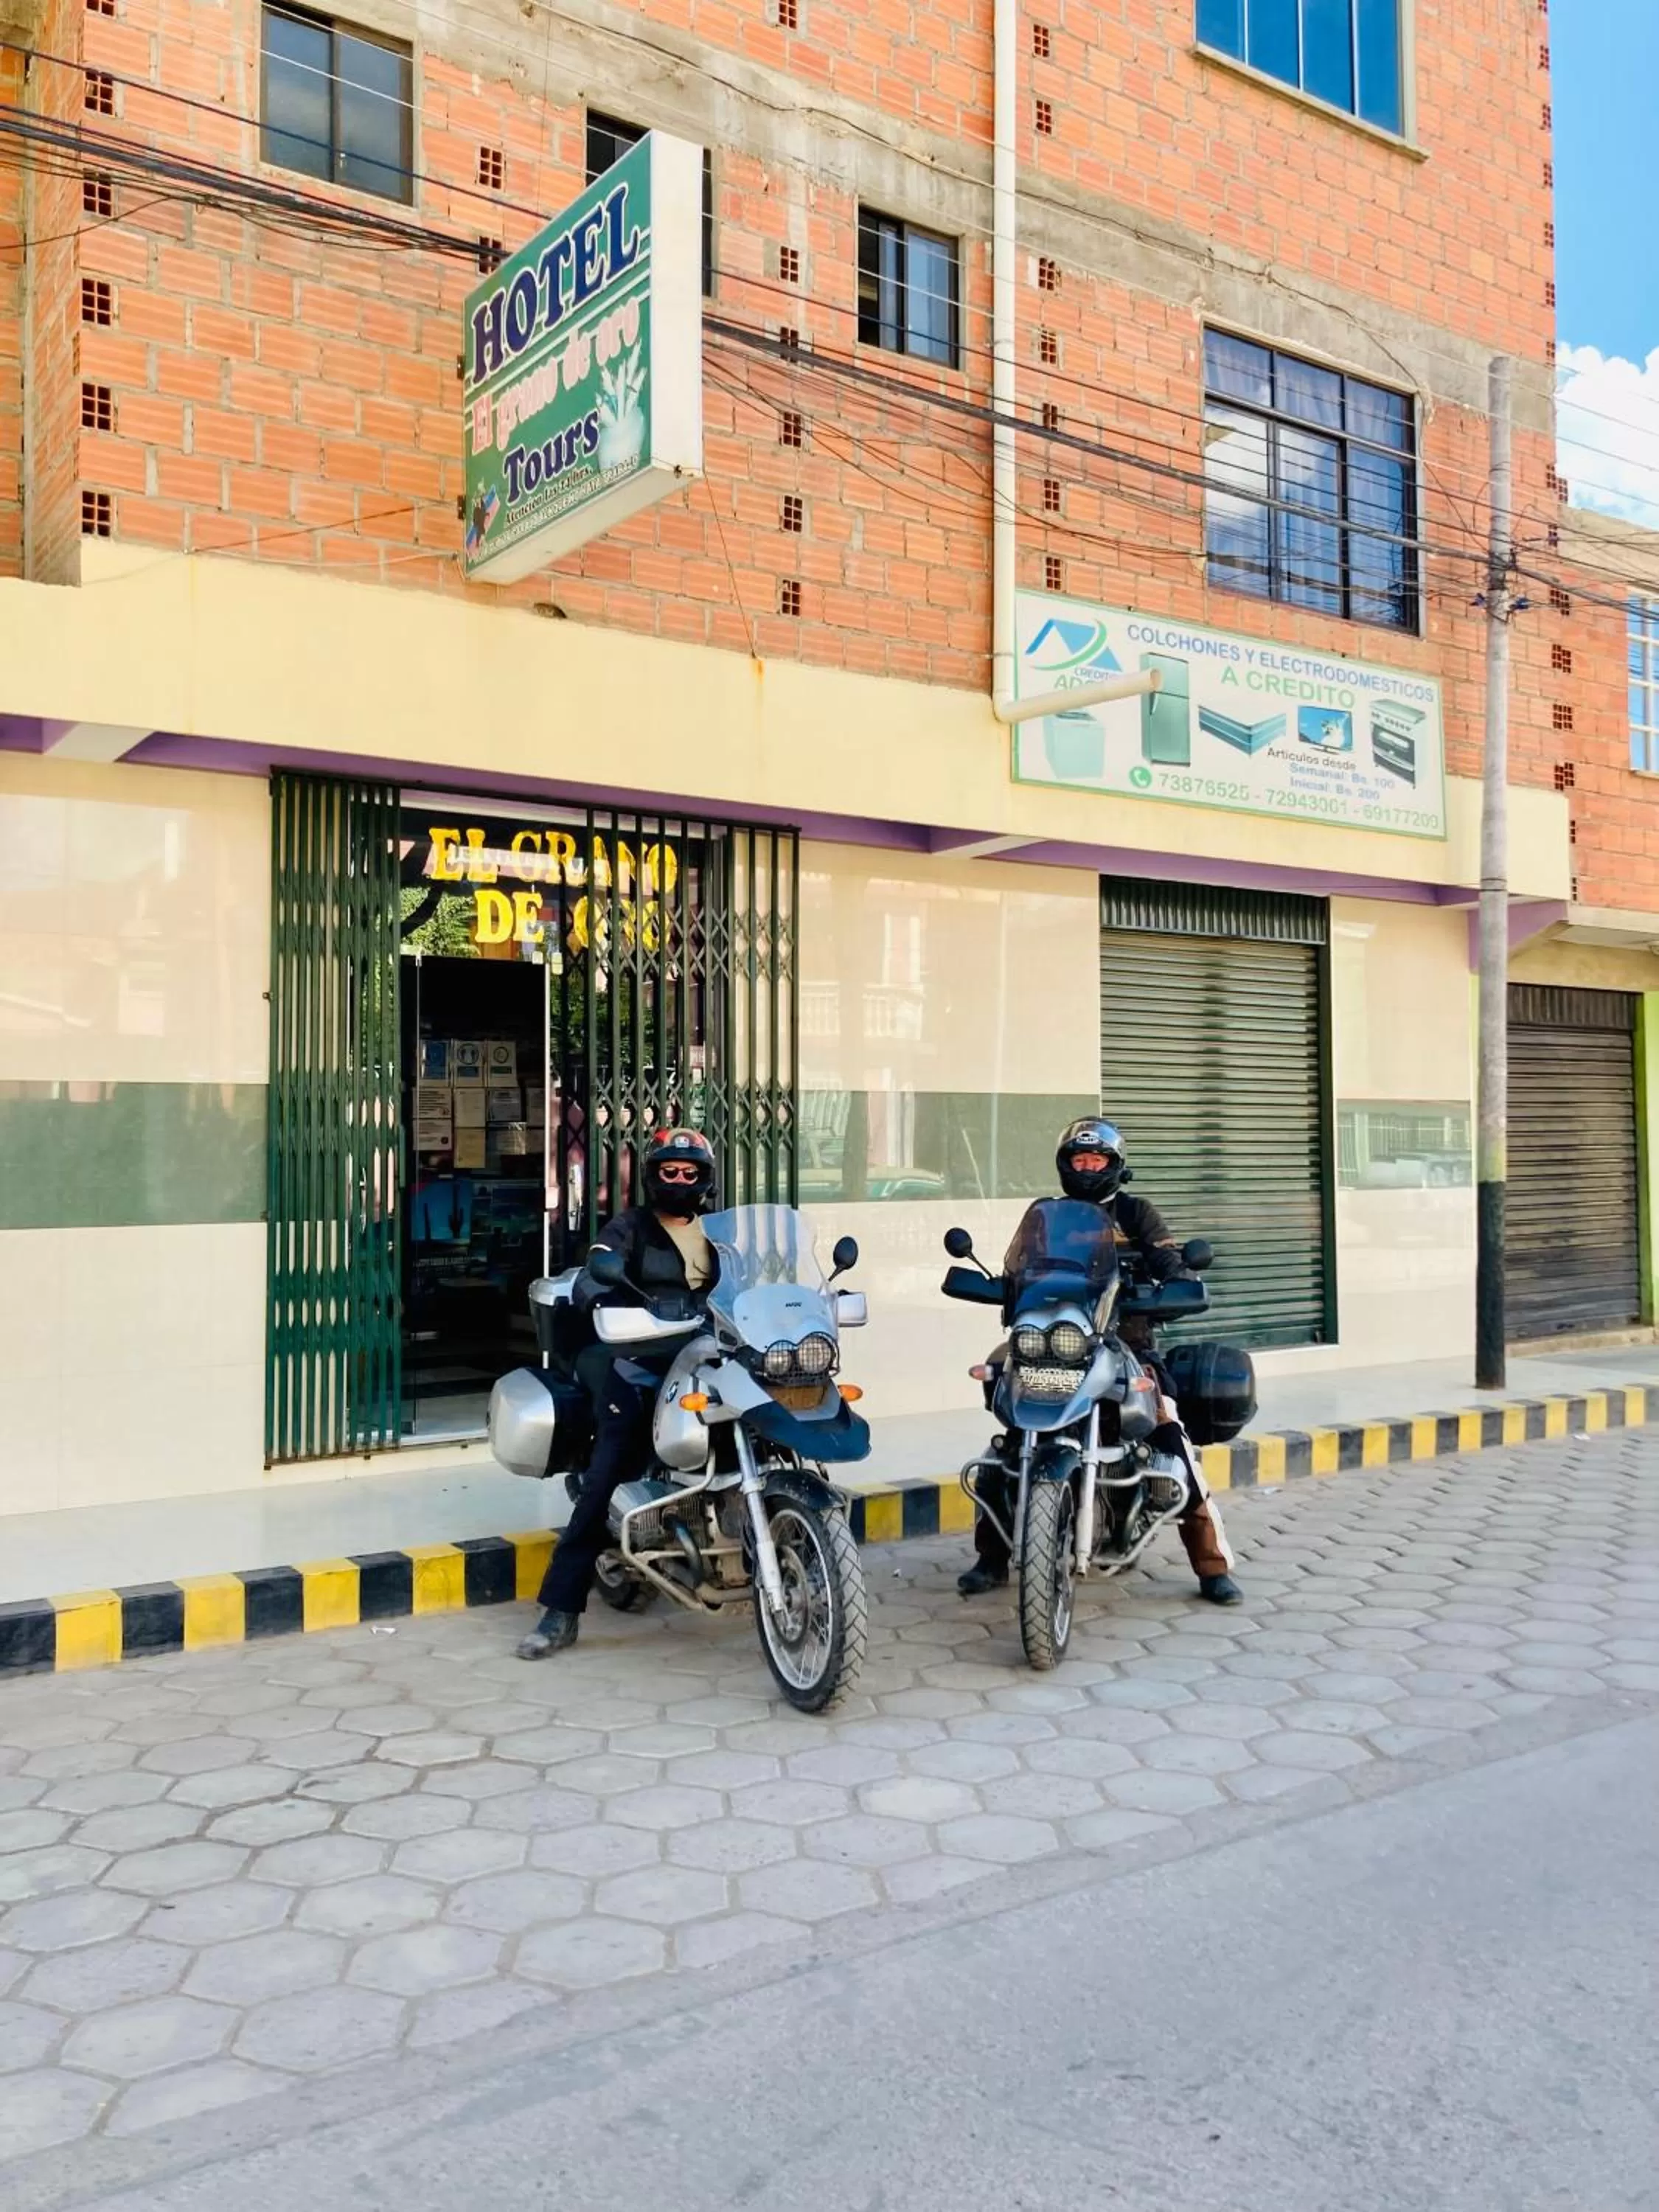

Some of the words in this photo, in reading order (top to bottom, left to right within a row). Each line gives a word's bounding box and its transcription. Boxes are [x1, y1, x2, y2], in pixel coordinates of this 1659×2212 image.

[471, 181, 640, 386] HOTEL
[503, 407, 600, 507] Tours
[1127, 624, 1241, 662] COLCHONES
[1244, 647, 1255, 663] Y
[1259, 651, 1435, 703] ELECTRODOMESTICOS
[1220, 665, 1239, 686] A
[1246, 669, 1355, 709] CREDITO
[1322, 757, 1357, 772] desde
[428, 827, 498, 884] EL
[511, 830, 678, 894] GRANO
[474, 888, 543, 944] DE
